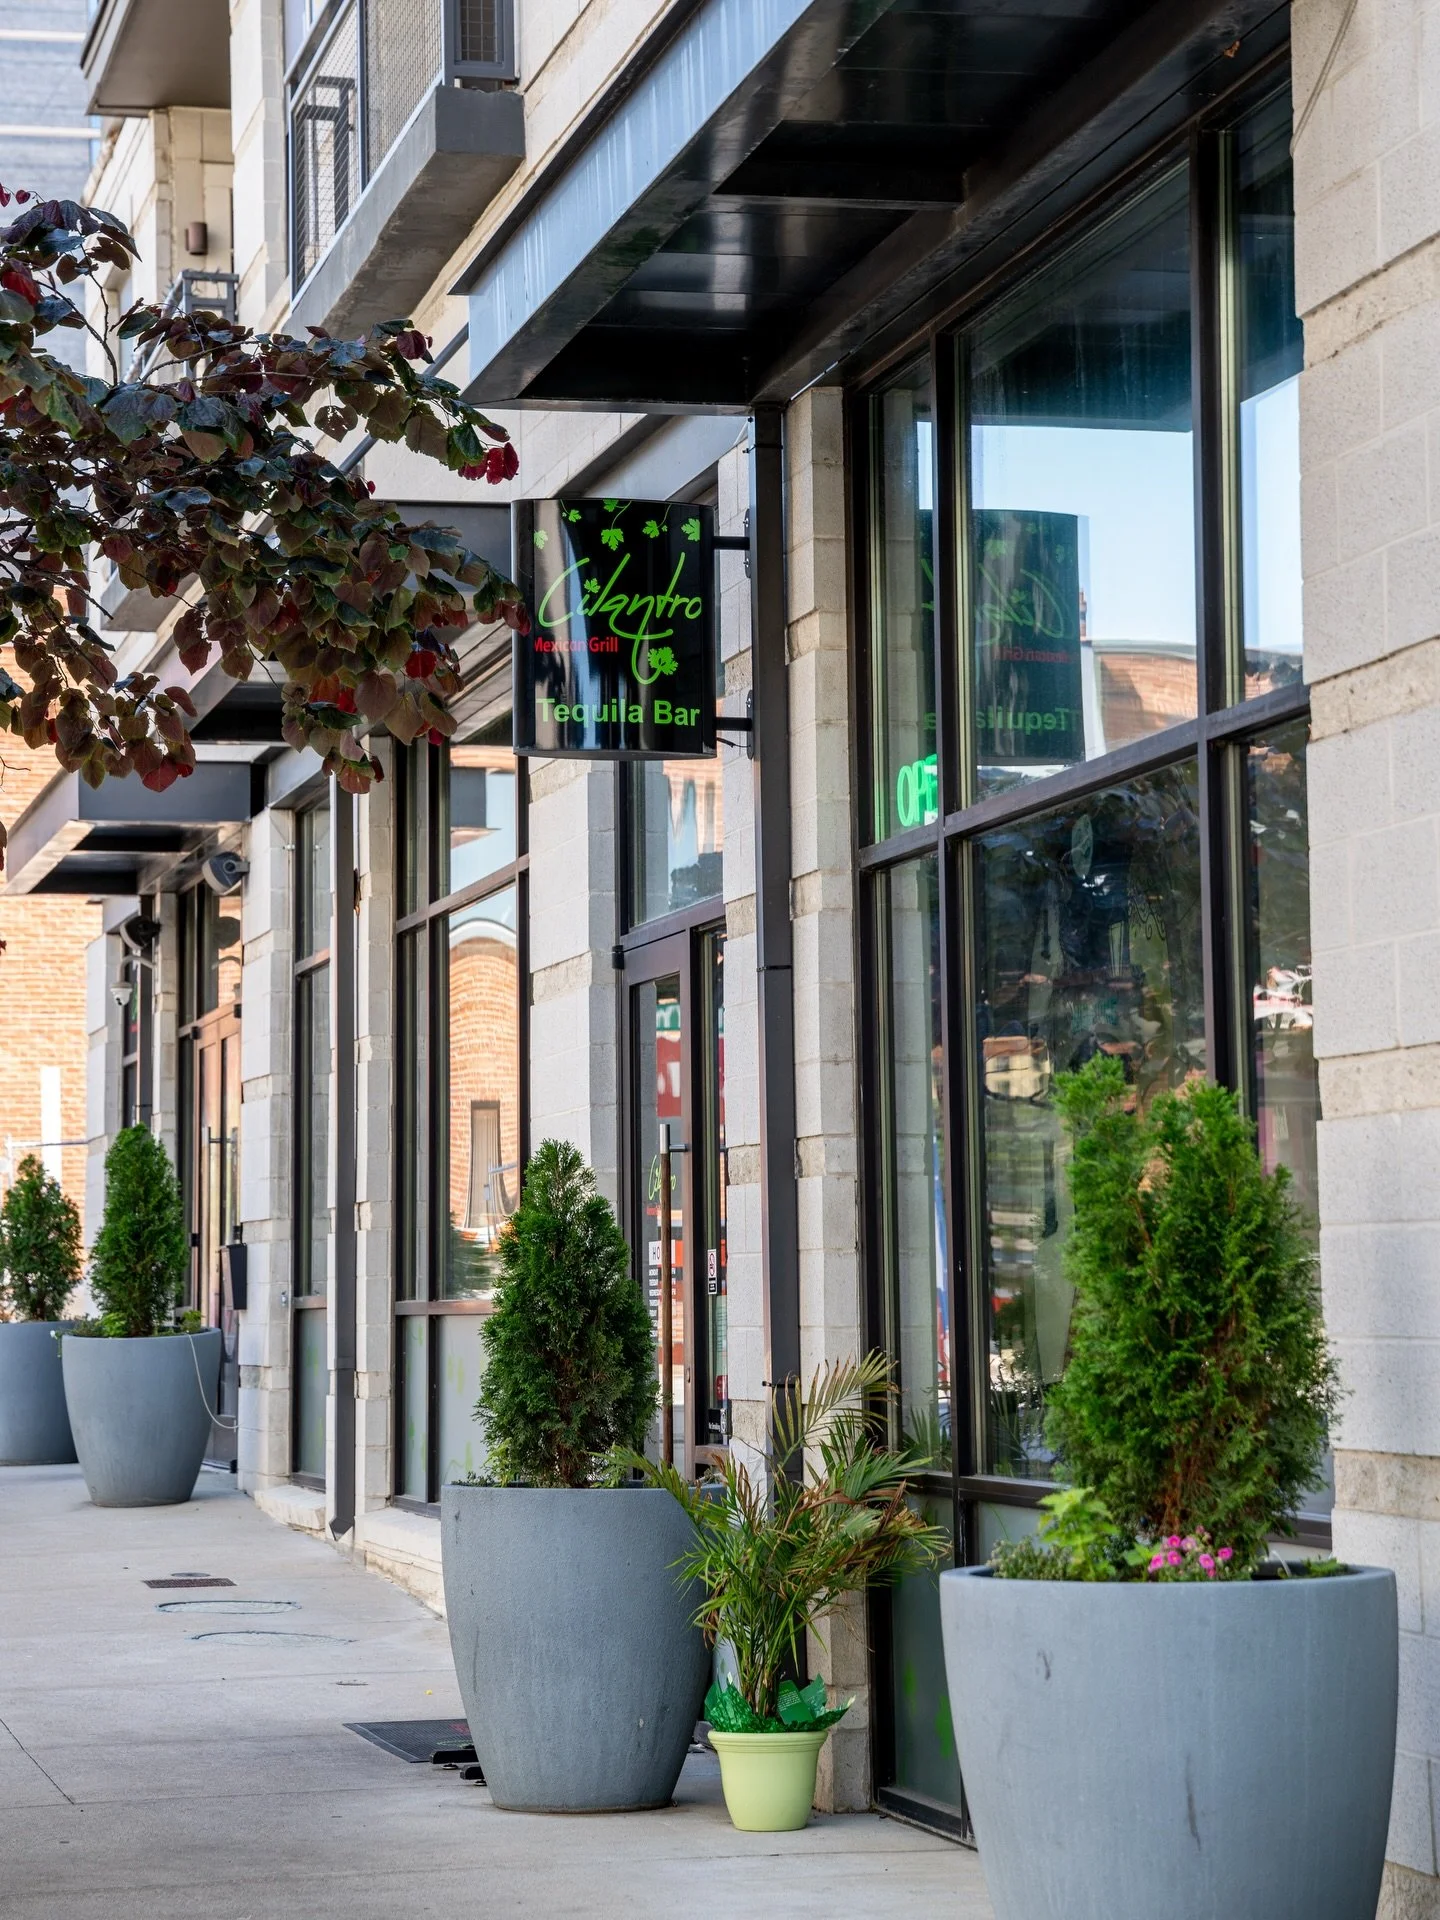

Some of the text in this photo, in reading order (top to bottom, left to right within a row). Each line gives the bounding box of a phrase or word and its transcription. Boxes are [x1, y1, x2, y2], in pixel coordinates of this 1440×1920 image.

[538, 553, 702, 685] Cilantro
[534, 636, 618, 653] Mexican Grill
[535, 698, 700, 728] Tequila Bar
